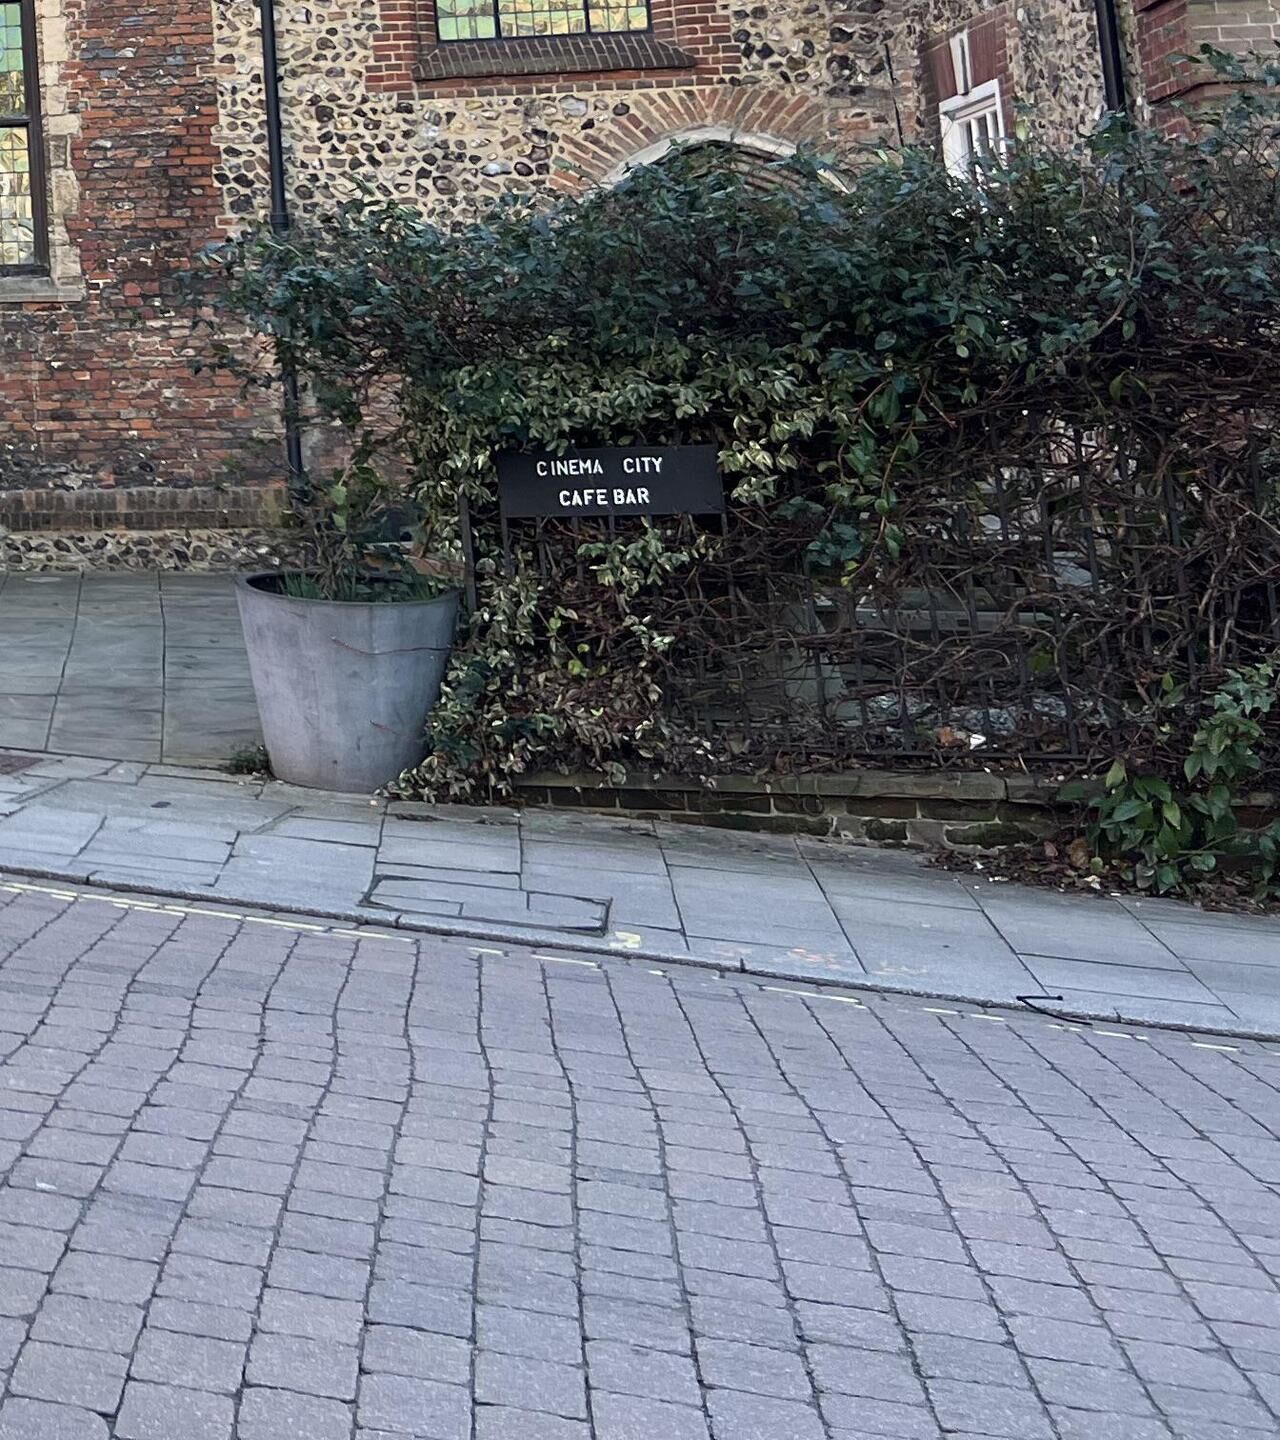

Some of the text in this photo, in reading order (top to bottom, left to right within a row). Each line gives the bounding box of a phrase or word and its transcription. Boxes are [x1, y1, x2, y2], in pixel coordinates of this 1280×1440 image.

[536, 456, 663, 477] CINEMA CITY
[559, 487, 650, 507] CAFE BAR
